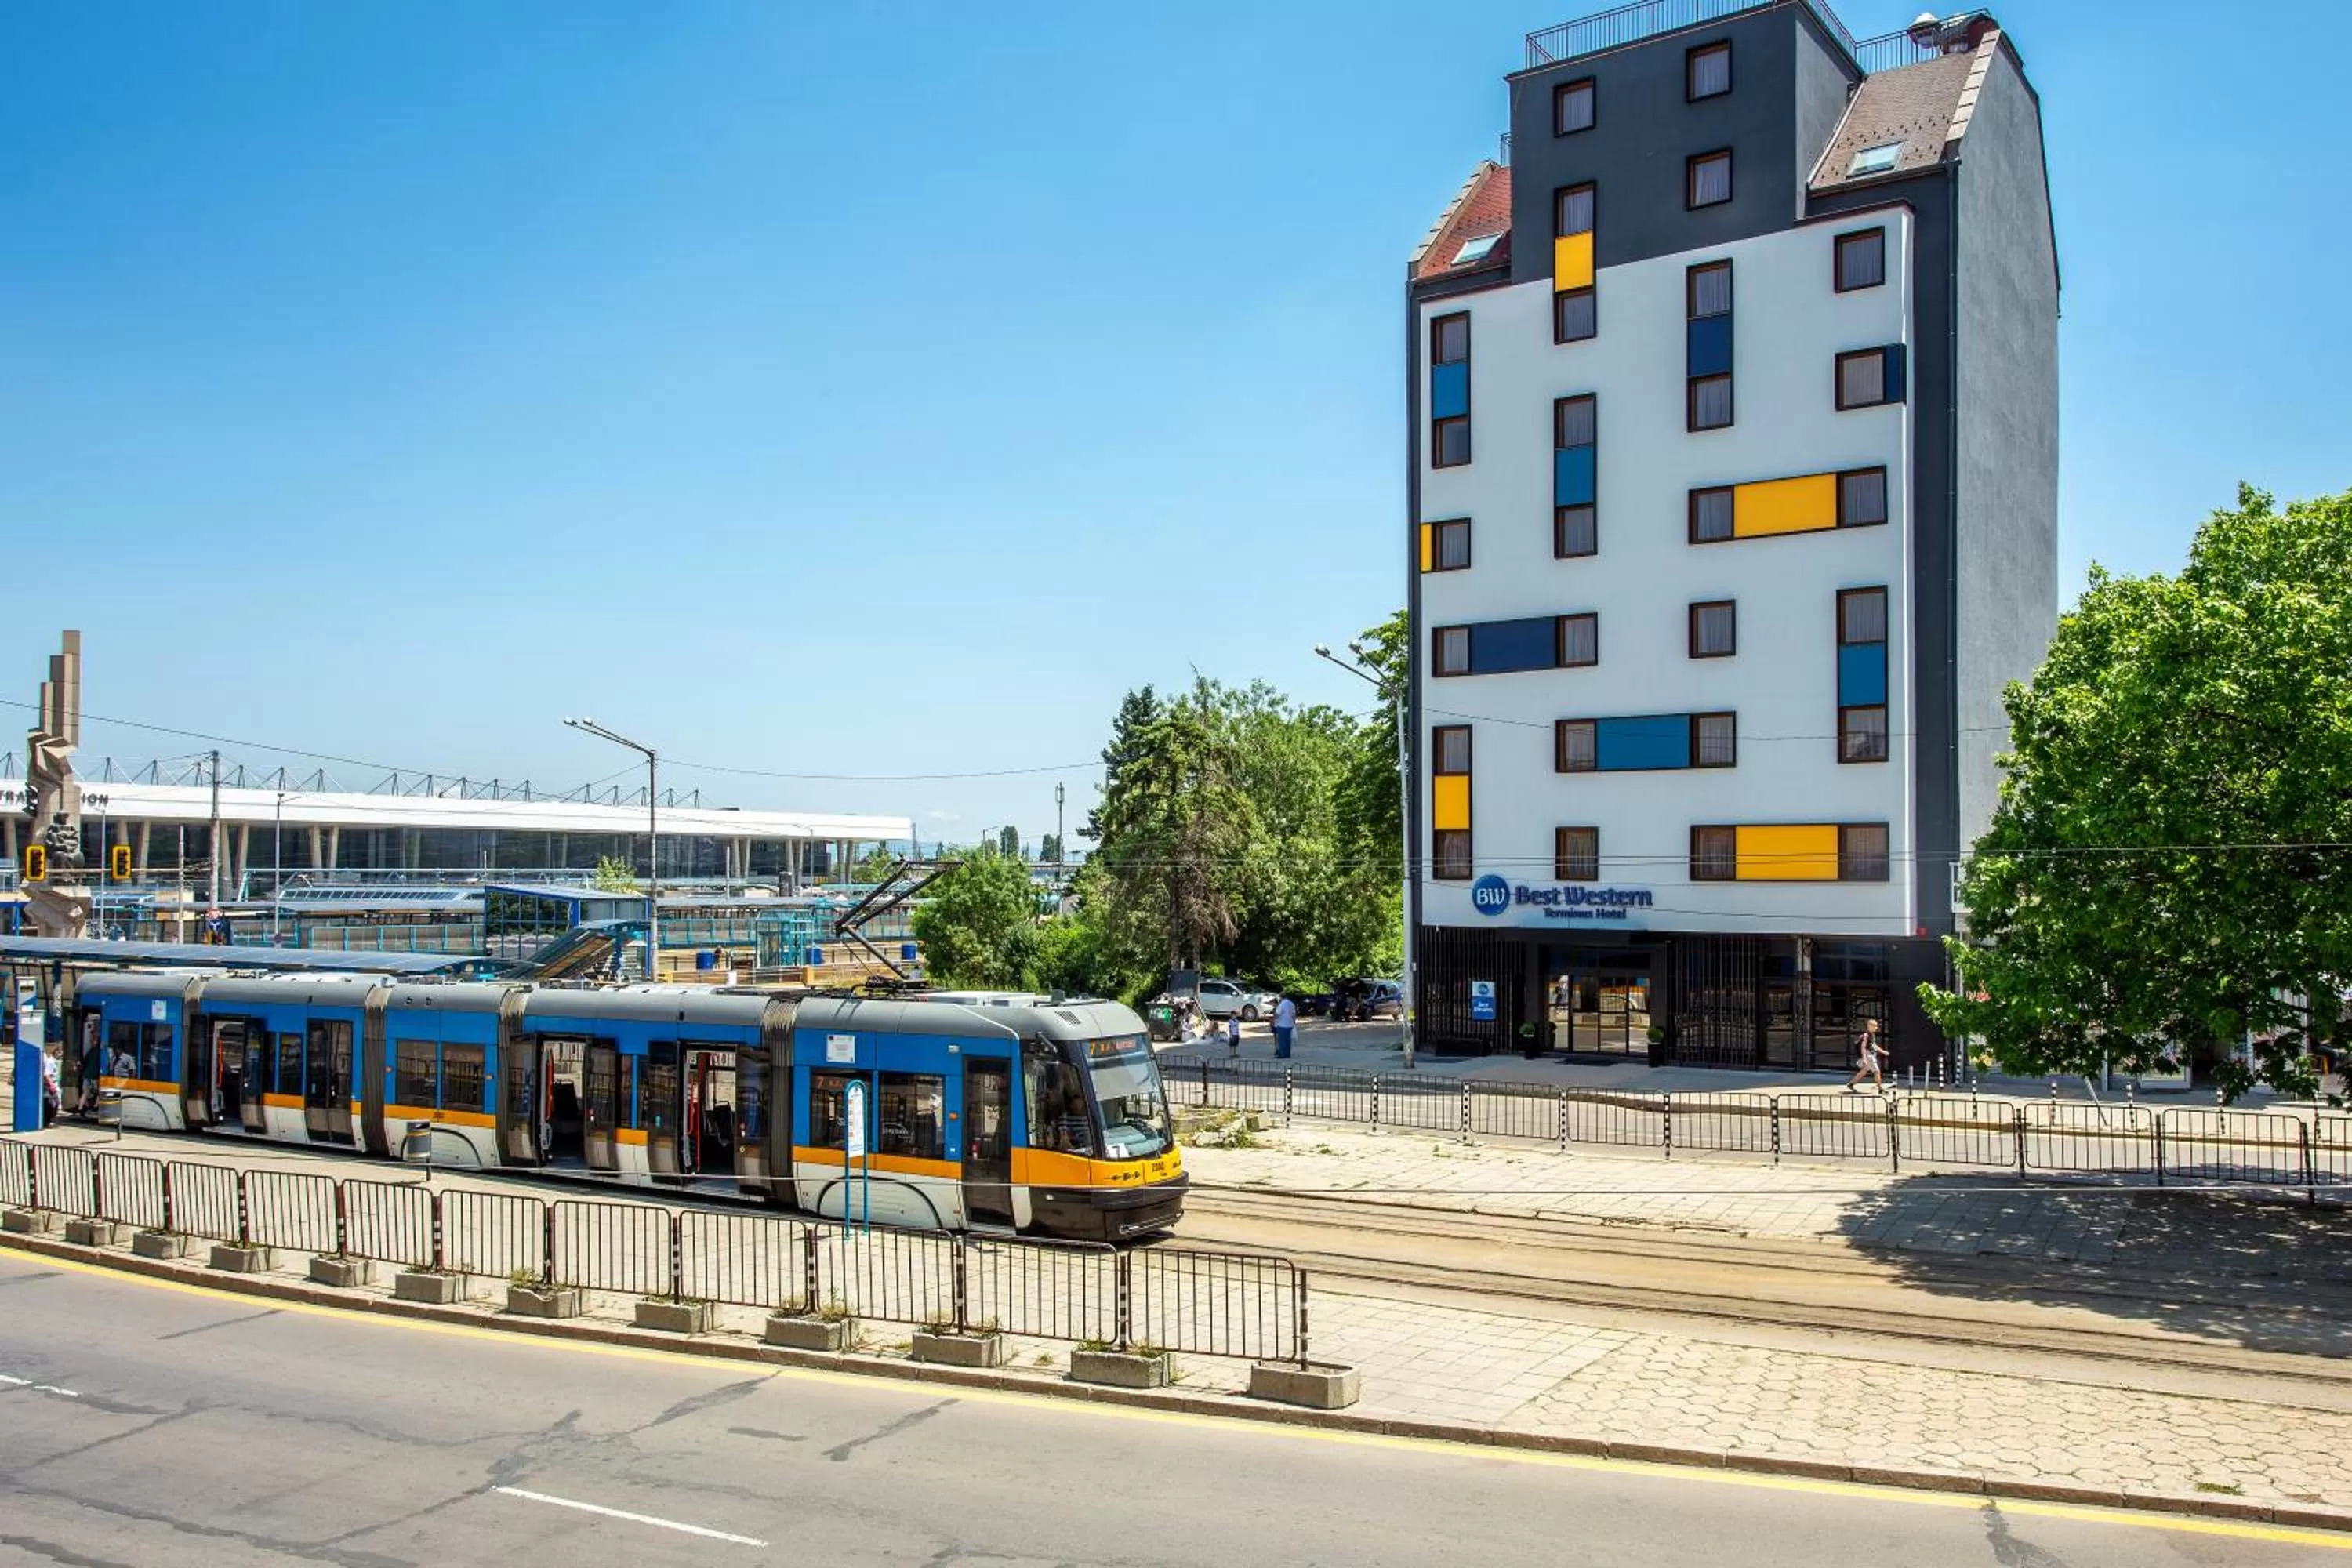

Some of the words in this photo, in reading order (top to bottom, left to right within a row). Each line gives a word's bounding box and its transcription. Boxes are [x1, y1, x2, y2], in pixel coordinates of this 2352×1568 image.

[1477, 887, 1505, 905] BW
[1515, 885, 1561, 906] Best
[1563, 885, 1653, 906] Western
[1542, 907, 1593, 919] Terminus
[1596, 907, 1626, 919] Hotel
